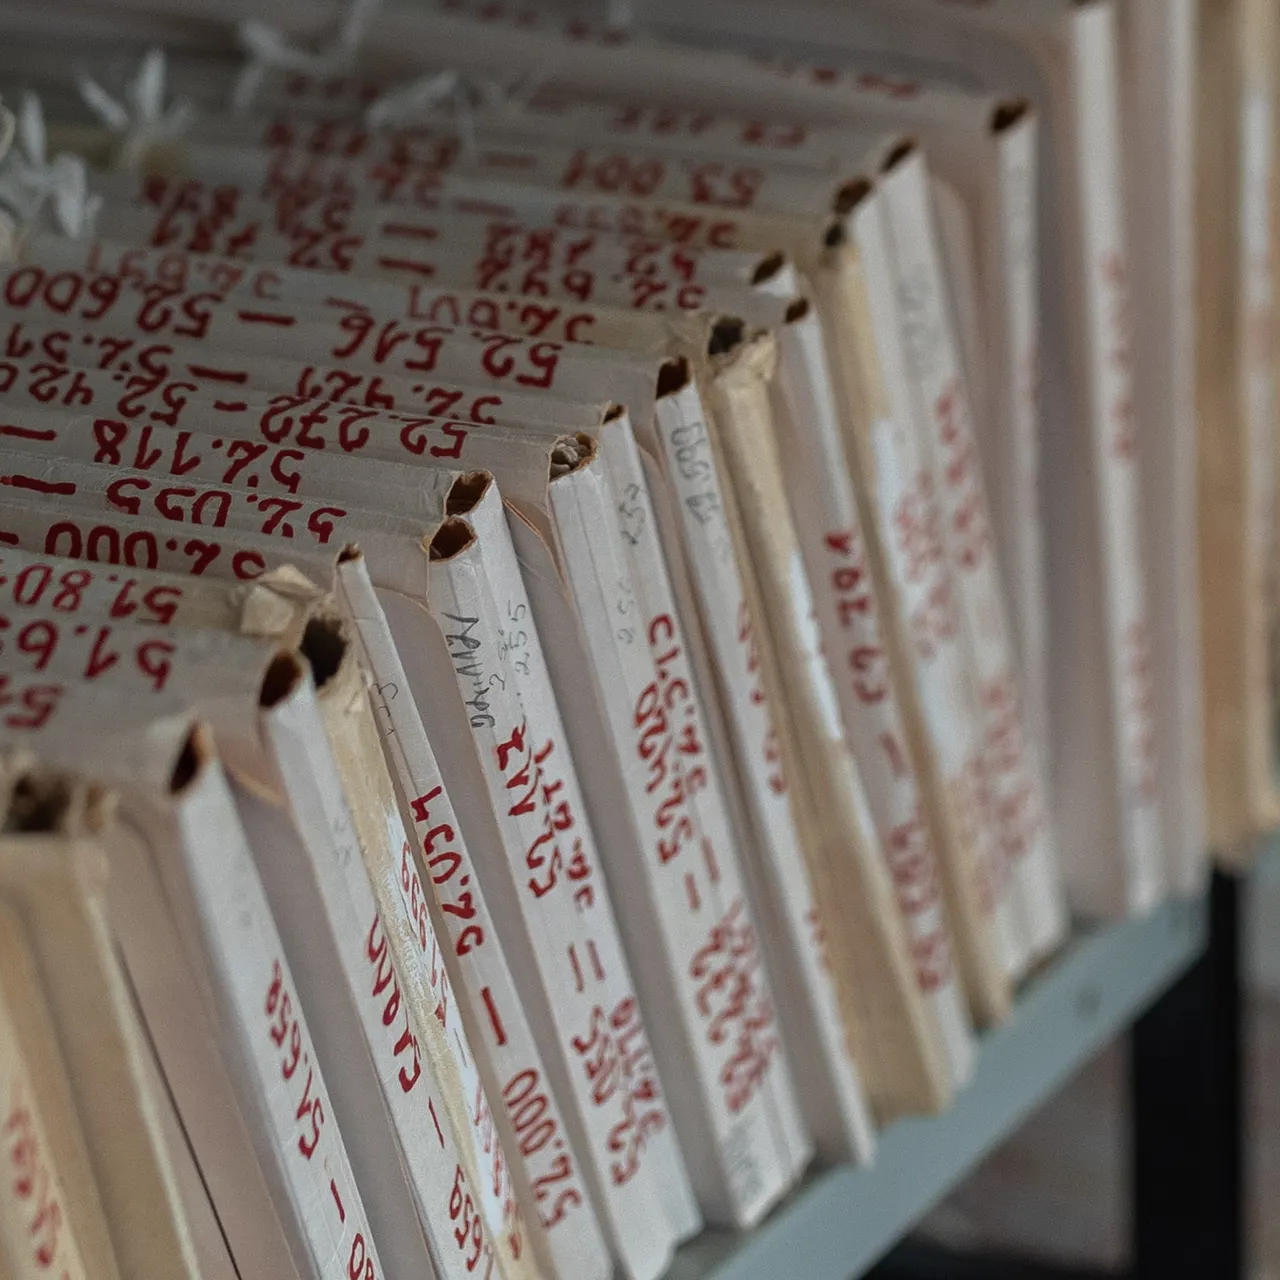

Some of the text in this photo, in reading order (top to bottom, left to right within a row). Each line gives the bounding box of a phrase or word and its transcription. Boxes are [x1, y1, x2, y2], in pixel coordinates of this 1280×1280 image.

[3, 265, 223, 339] 52.600
[332, 314, 564, 389] 52.516
[258, 394, 469, 460] 52.272
[497, 723, 563, 897] 52.117
[264, 958, 326, 1159] 51.658
[504, 1068, 581, 1231] 52.000
